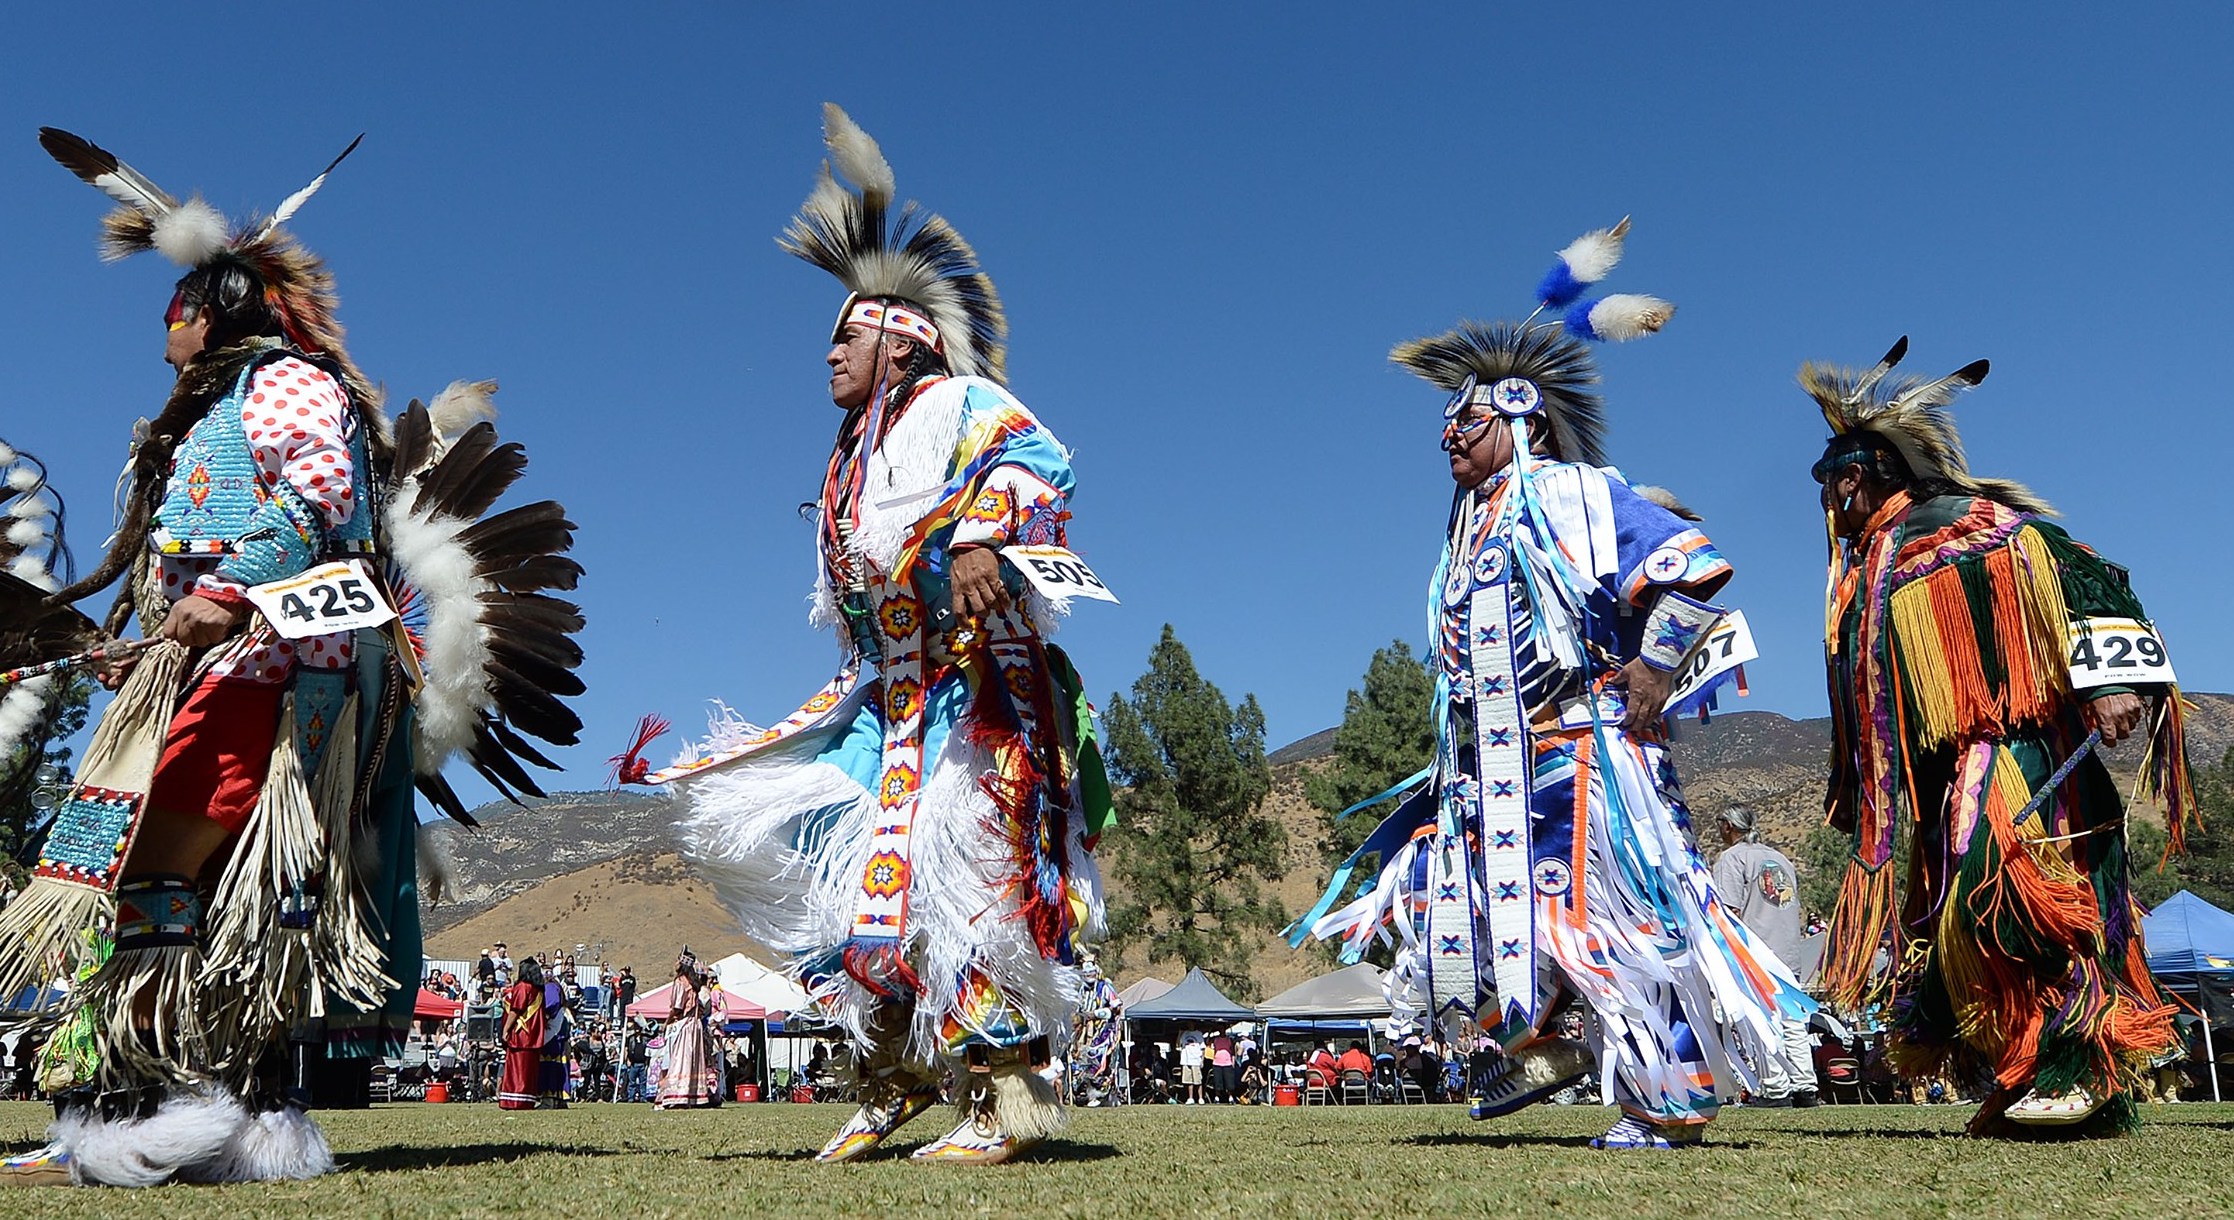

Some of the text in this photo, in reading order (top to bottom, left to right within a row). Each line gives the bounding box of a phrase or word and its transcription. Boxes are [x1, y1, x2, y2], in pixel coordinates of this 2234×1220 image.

[1027, 558, 1104, 589] 505
[281, 579, 375, 622] 425
[1675, 630, 1737, 698] 507
[2069, 636, 2166, 671] 429
